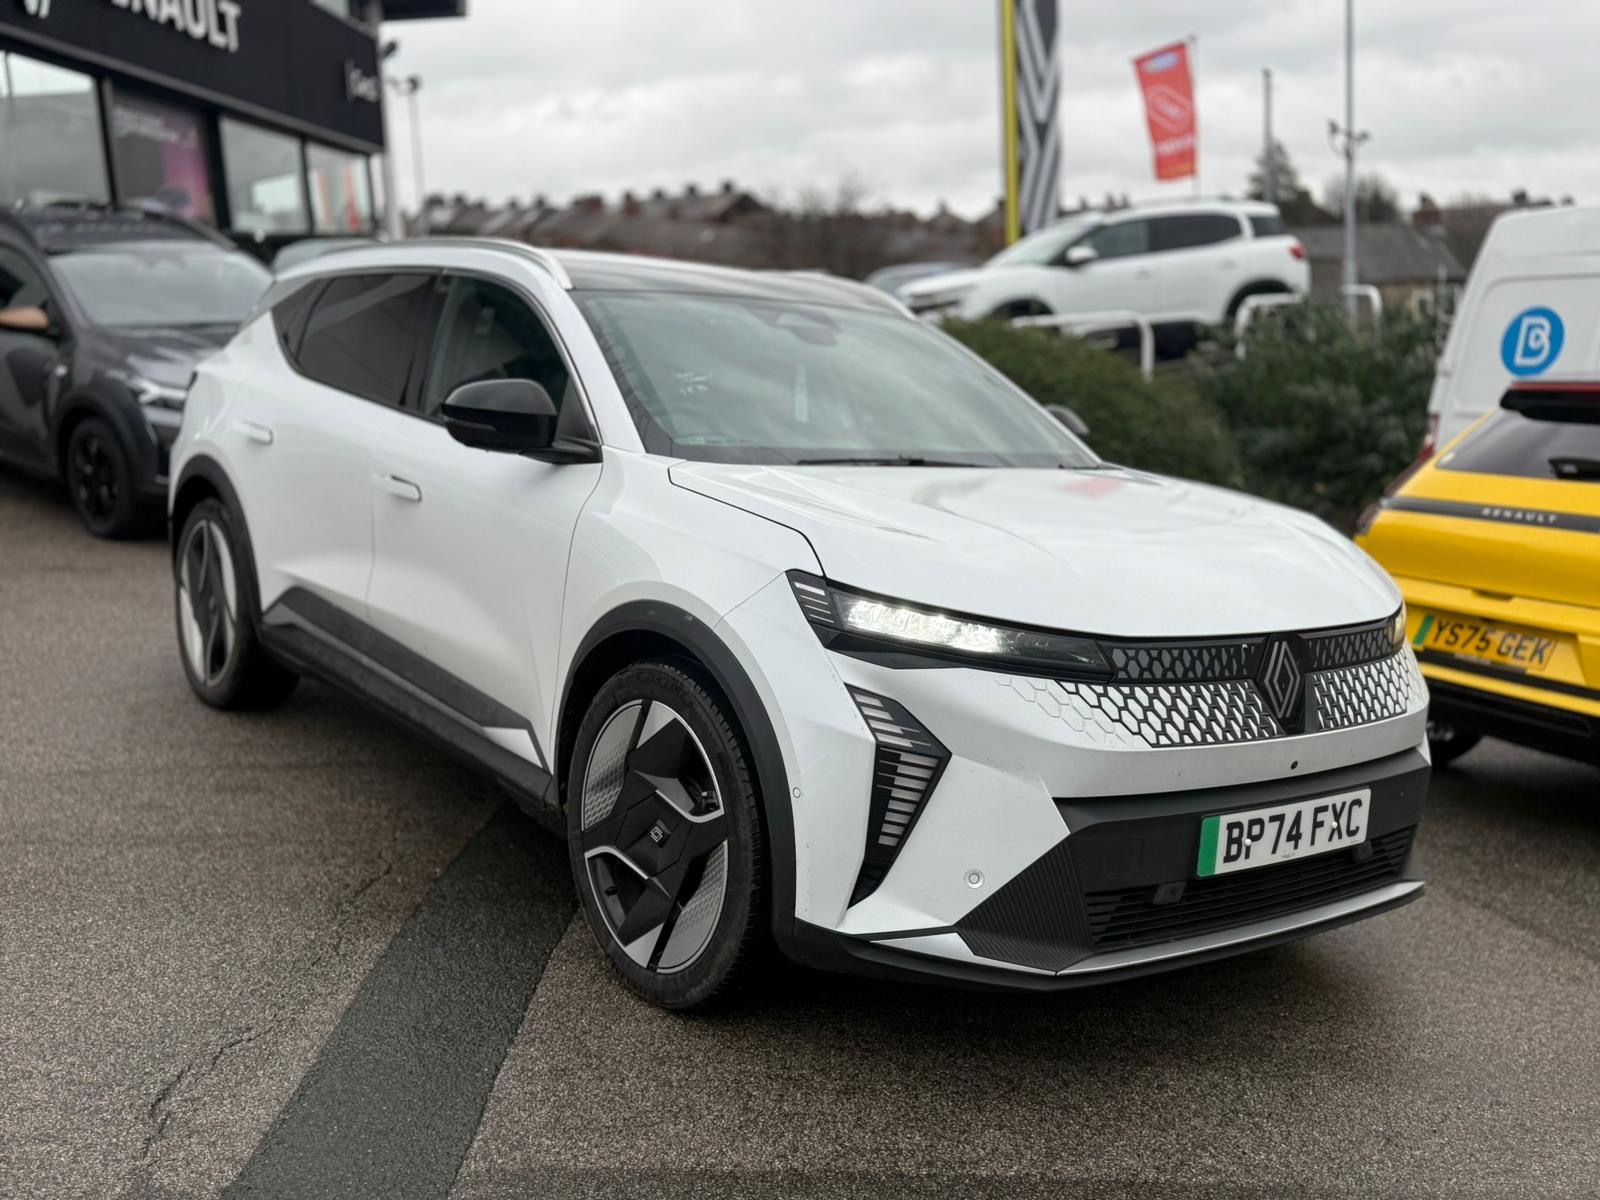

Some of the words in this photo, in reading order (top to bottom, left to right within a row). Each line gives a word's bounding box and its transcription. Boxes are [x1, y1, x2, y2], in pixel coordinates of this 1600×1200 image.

[1482, 507, 1557, 523] RENAULT
[1432, 620, 1496, 652] YS75
[1497, 631, 1553, 665] GEK
[1223, 810, 1302, 864] BP74
[1310, 798, 1363, 847] FXC
